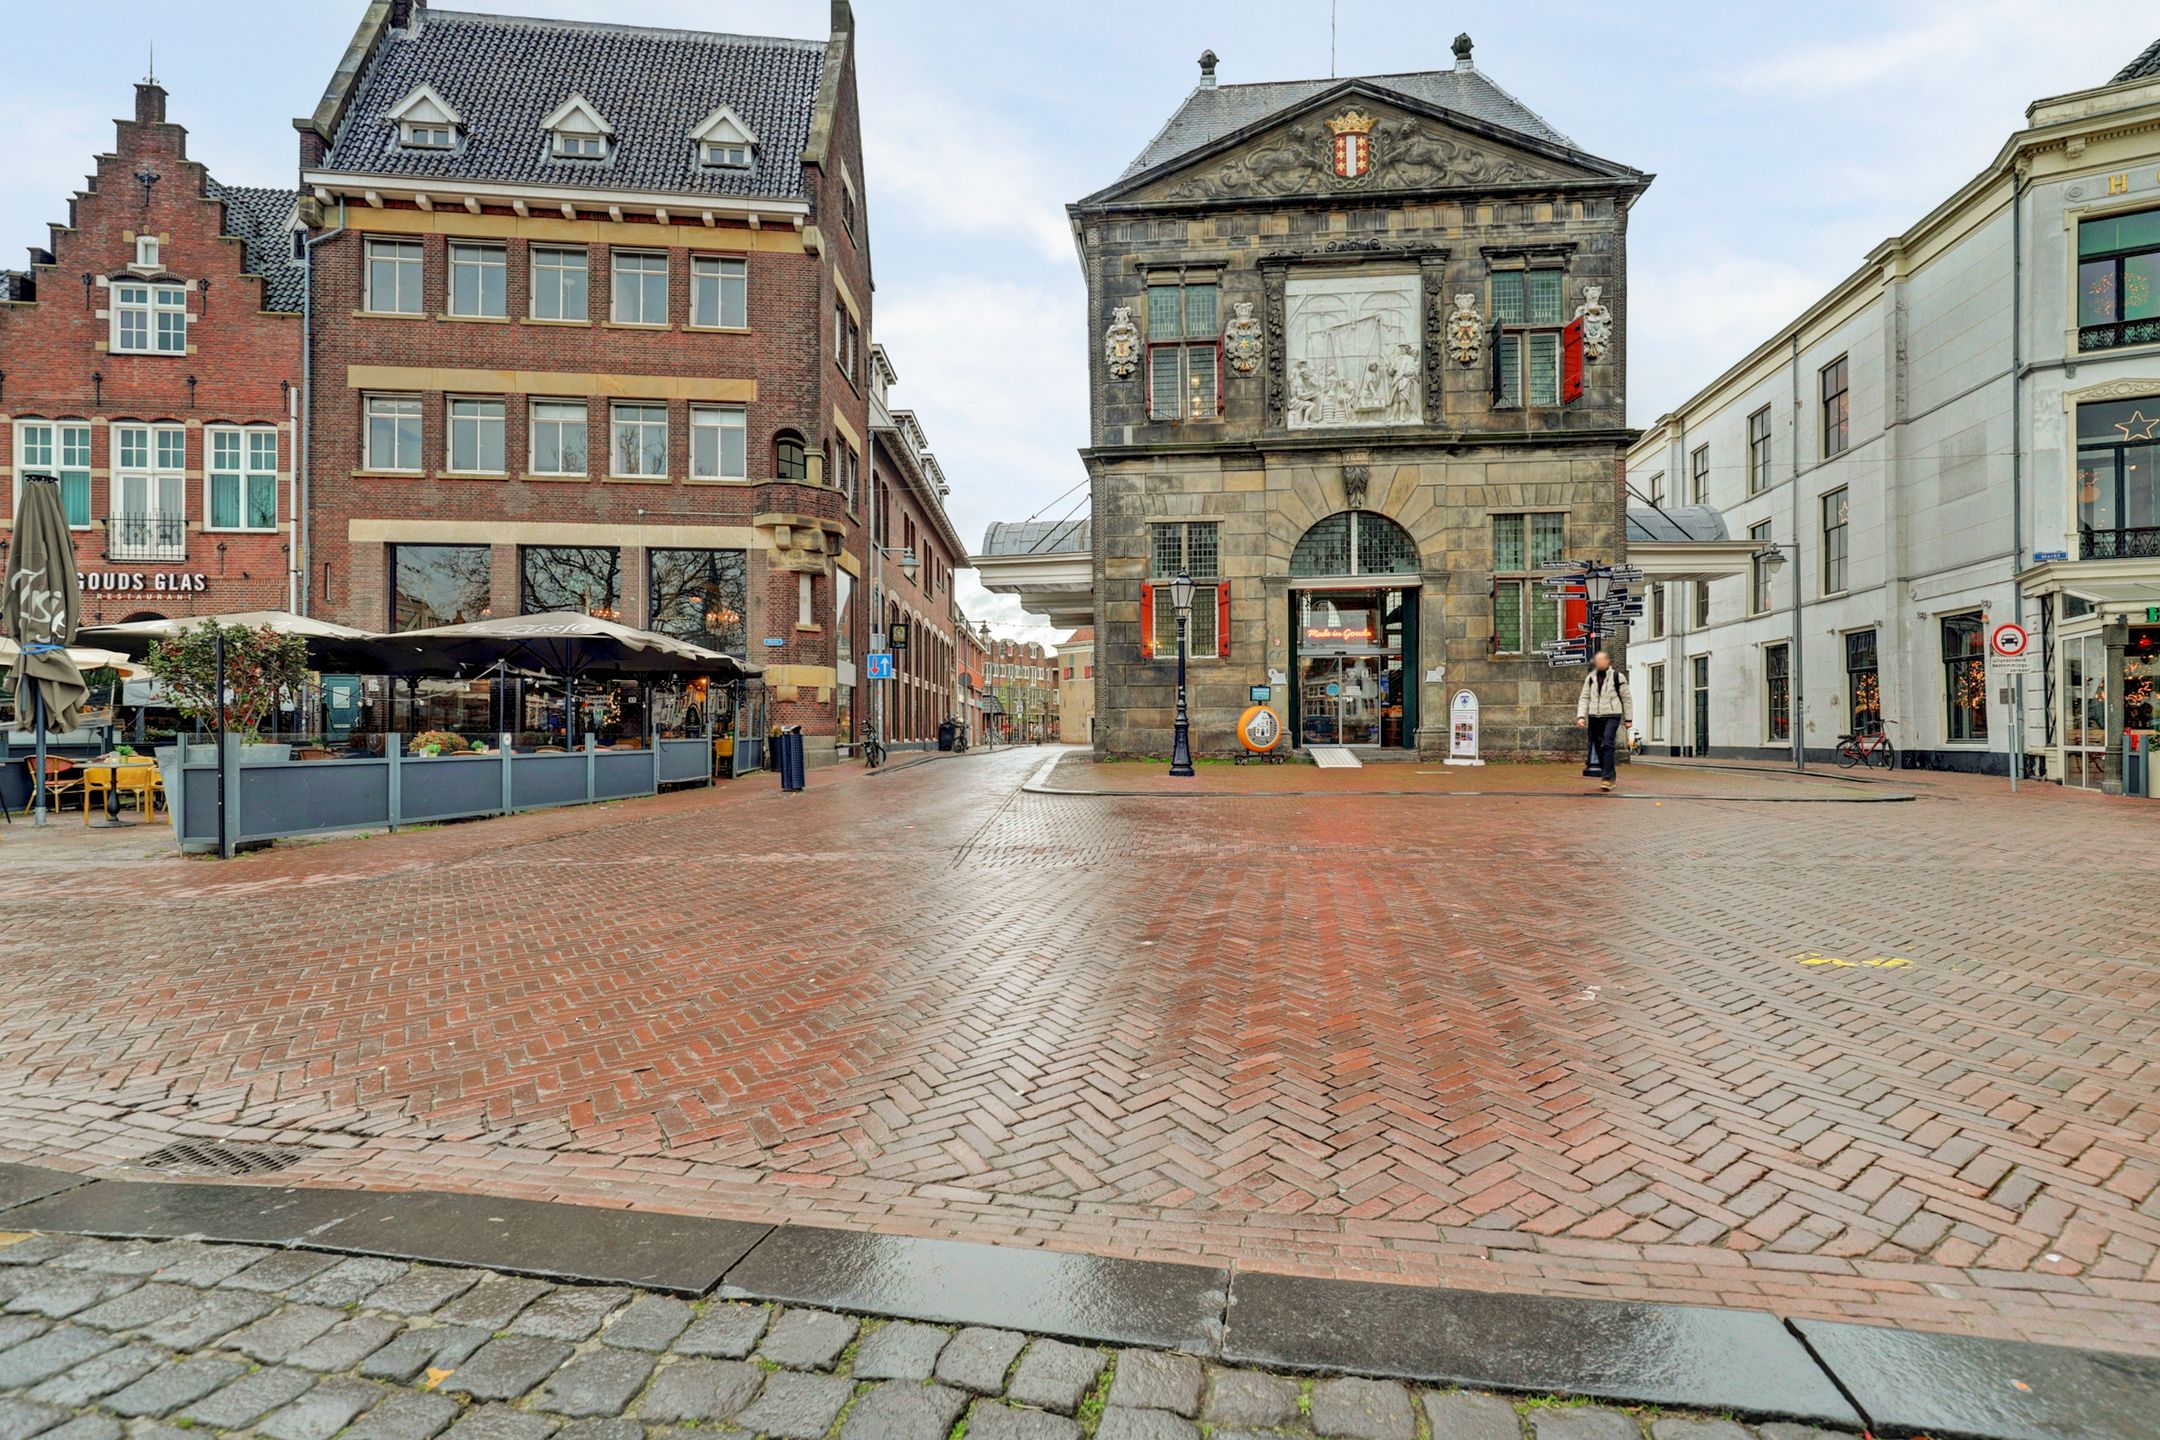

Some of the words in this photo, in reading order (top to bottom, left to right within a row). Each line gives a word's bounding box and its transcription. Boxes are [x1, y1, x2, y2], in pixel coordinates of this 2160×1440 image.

[154, 573, 207, 592] GLAS
[1308, 628, 1330, 638] Made
[1332, 629, 1342, 637] in
